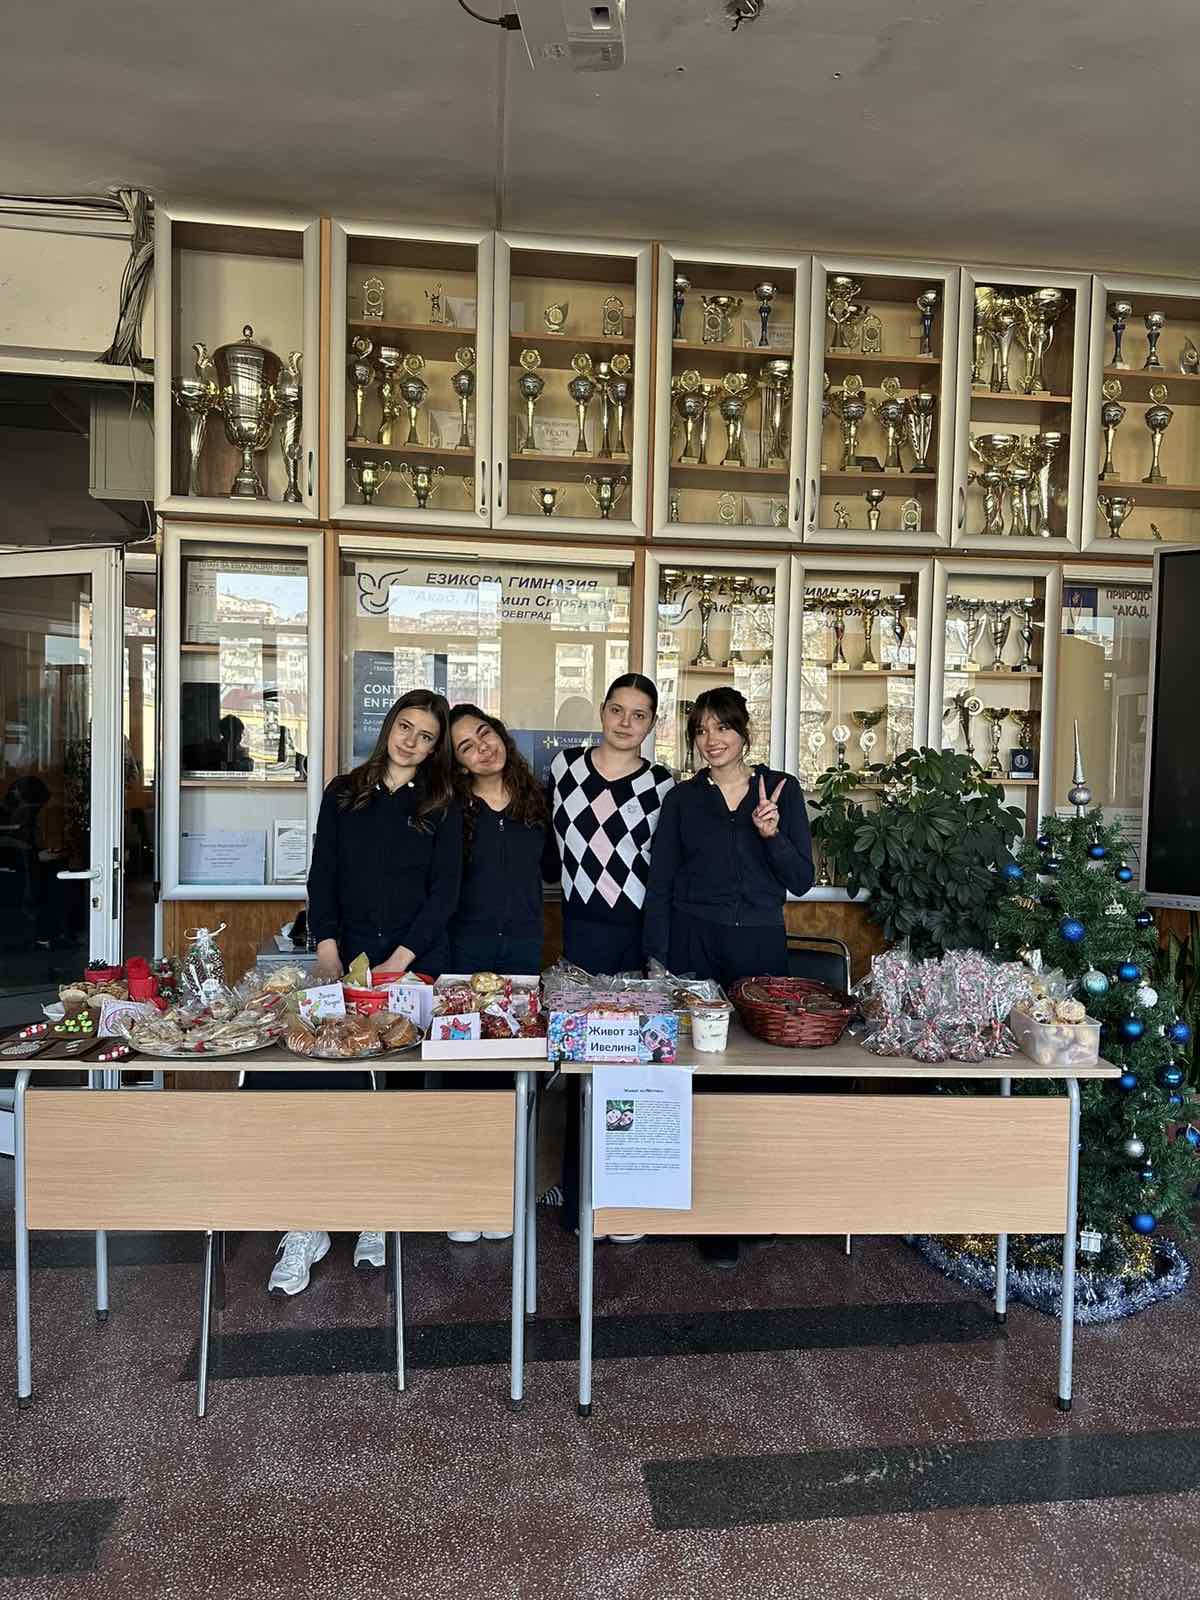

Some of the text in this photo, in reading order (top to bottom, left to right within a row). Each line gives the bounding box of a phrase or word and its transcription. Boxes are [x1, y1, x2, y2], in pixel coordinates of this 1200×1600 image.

[508, 576, 599, 592] ГИМНАЗИЯ
[804, 586, 881, 599] ИМНАЗИЯ
[363, 697, 381, 708] EN
[588, 1026, 639, 1037] Живот за
[590, 1042, 637, 1053] Ивелина
